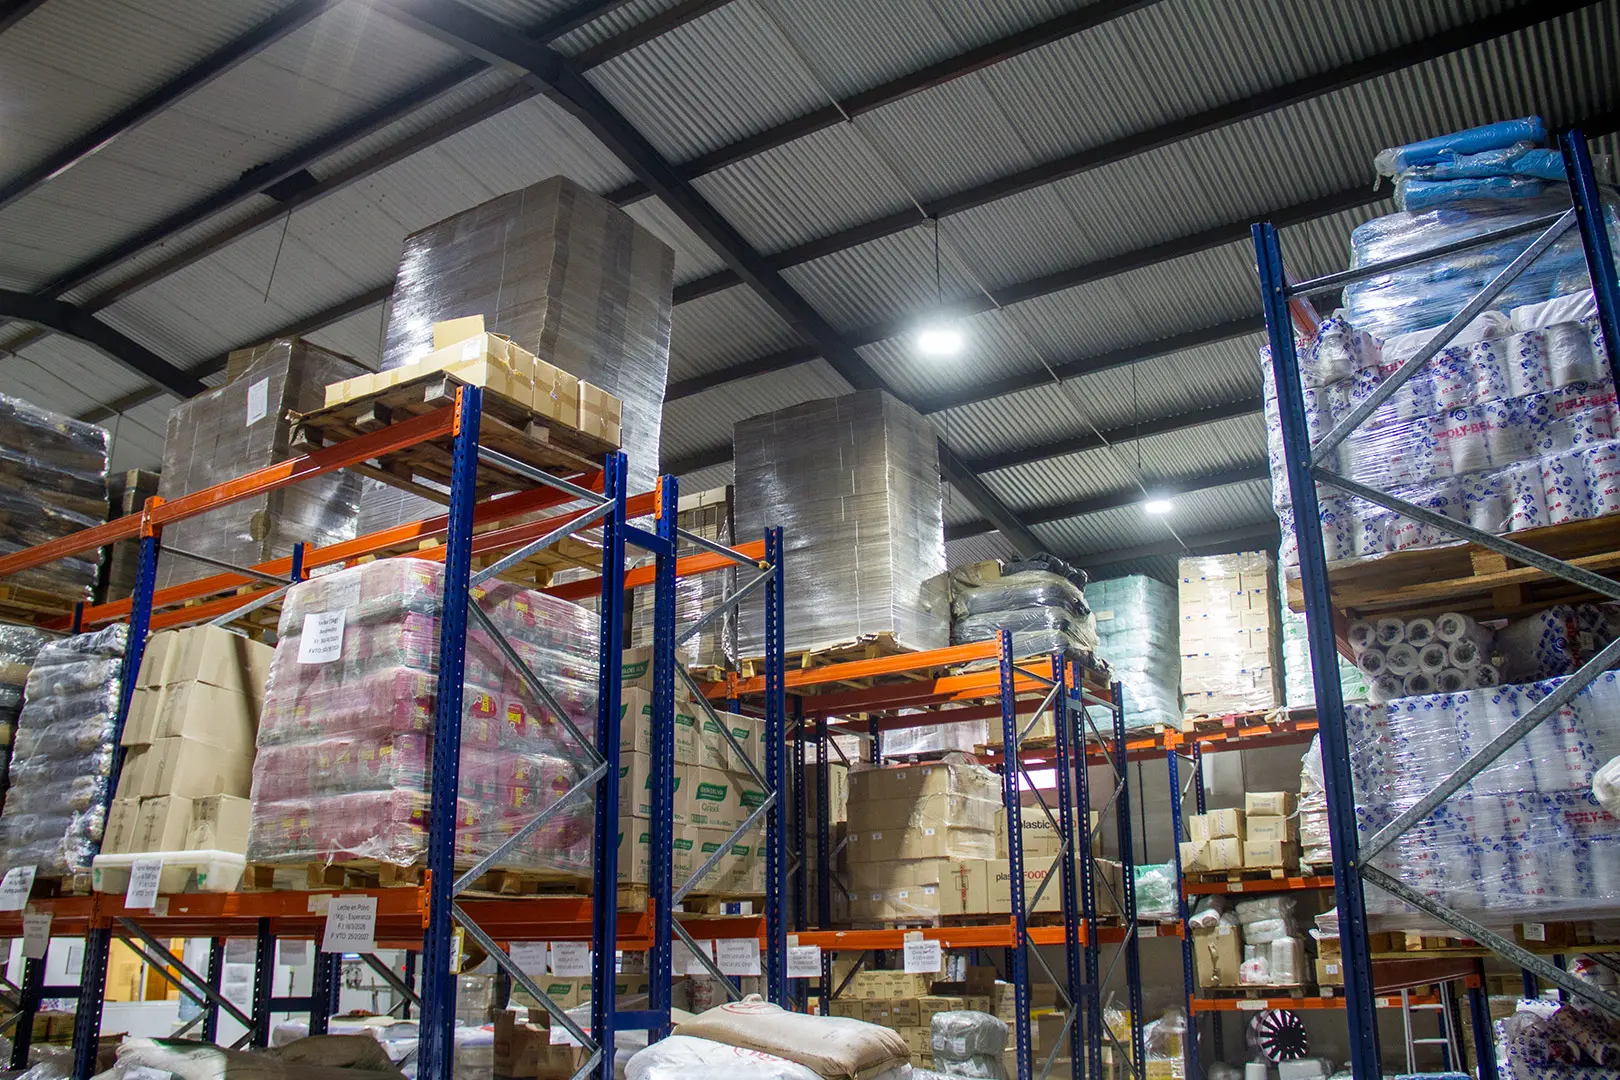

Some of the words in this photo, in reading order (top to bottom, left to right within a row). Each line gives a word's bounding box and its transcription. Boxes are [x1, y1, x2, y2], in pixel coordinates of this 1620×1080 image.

[337, 903, 350, 911] Leche
[358, 903, 370, 911] Polvo
[348, 912, 372, 921] Esperanza
